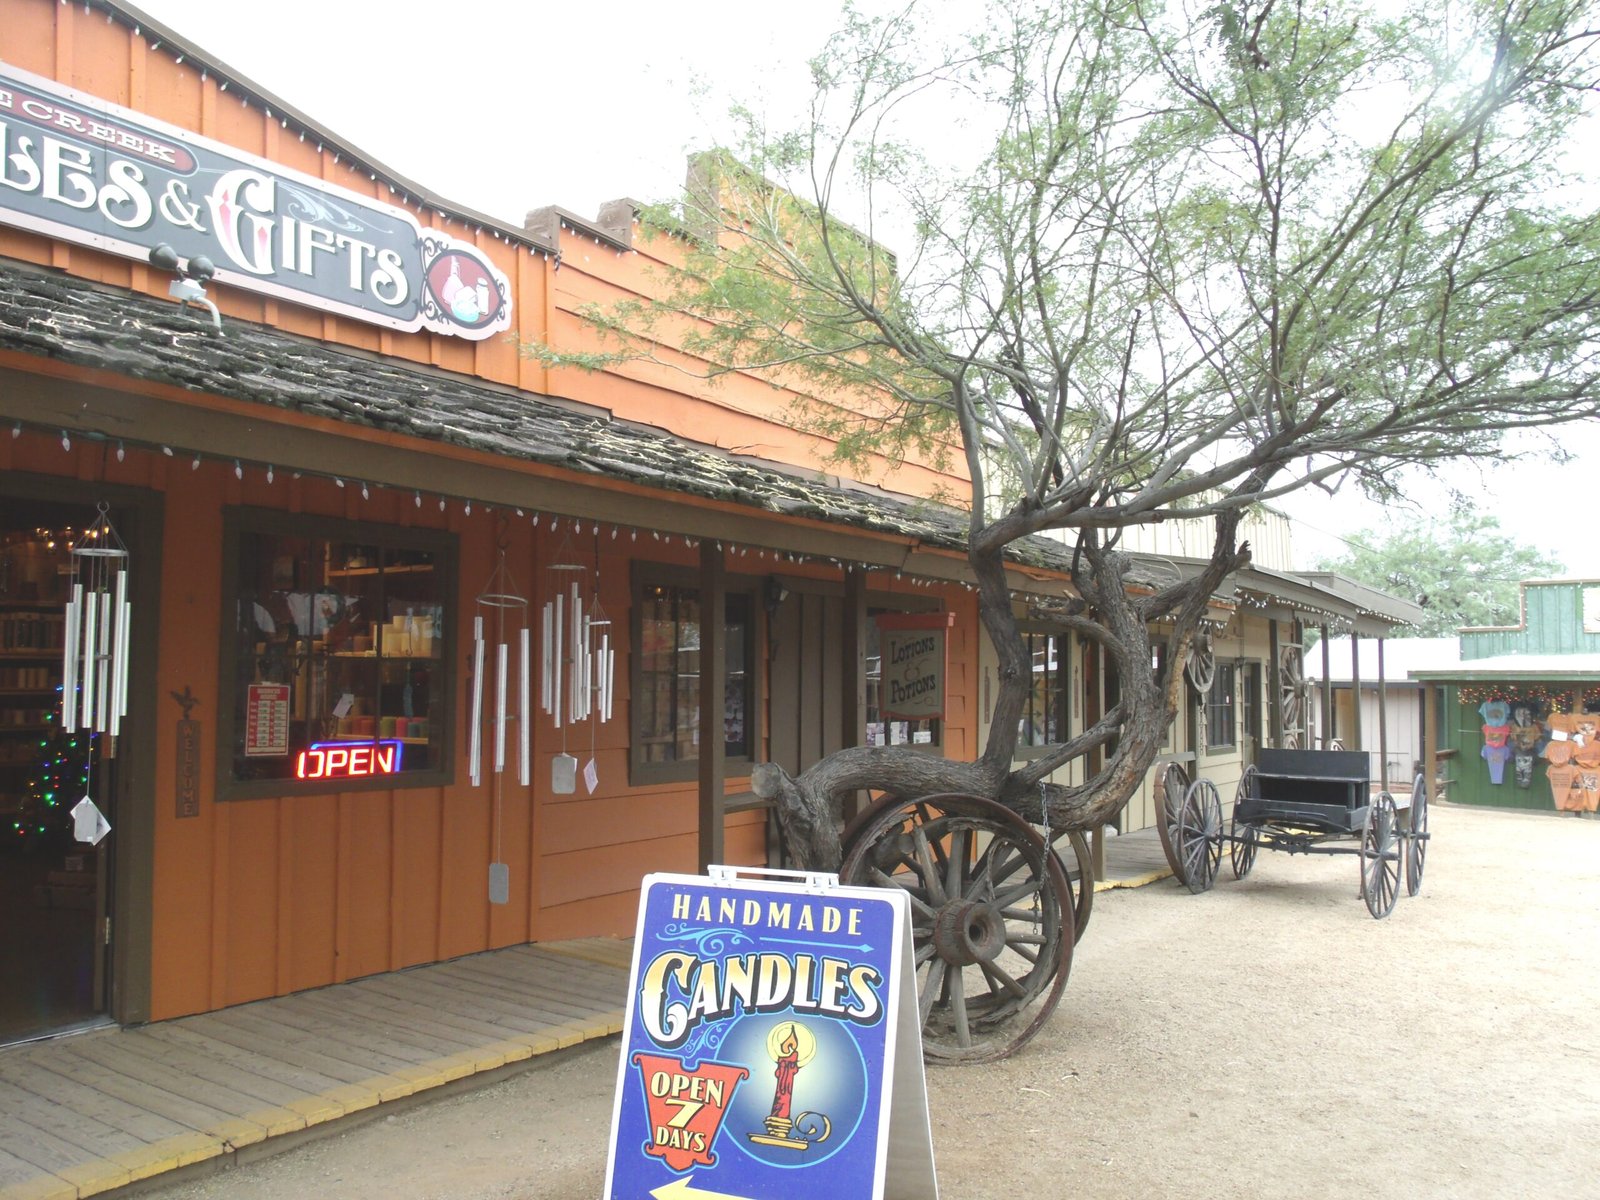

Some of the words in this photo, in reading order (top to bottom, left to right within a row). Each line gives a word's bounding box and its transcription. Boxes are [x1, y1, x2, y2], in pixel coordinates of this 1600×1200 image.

[22, 100, 176, 165] CREEK
[159, 178, 207, 232] &
[205, 169, 410, 306] GIFTS
[891, 637, 935, 664] LOTIONS
[891, 674, 936, 703] POTIONS
[296, 746, 394, 779] OPEN
[672, 893, 863, 935] HANDMADE
[640, 951, 884, 1046] CANDLES
[650, 1071, 725, 1107] OPEN
[665, 1098, 705, 1128] 7
[655, 1125, 706, 1153] DAYS
